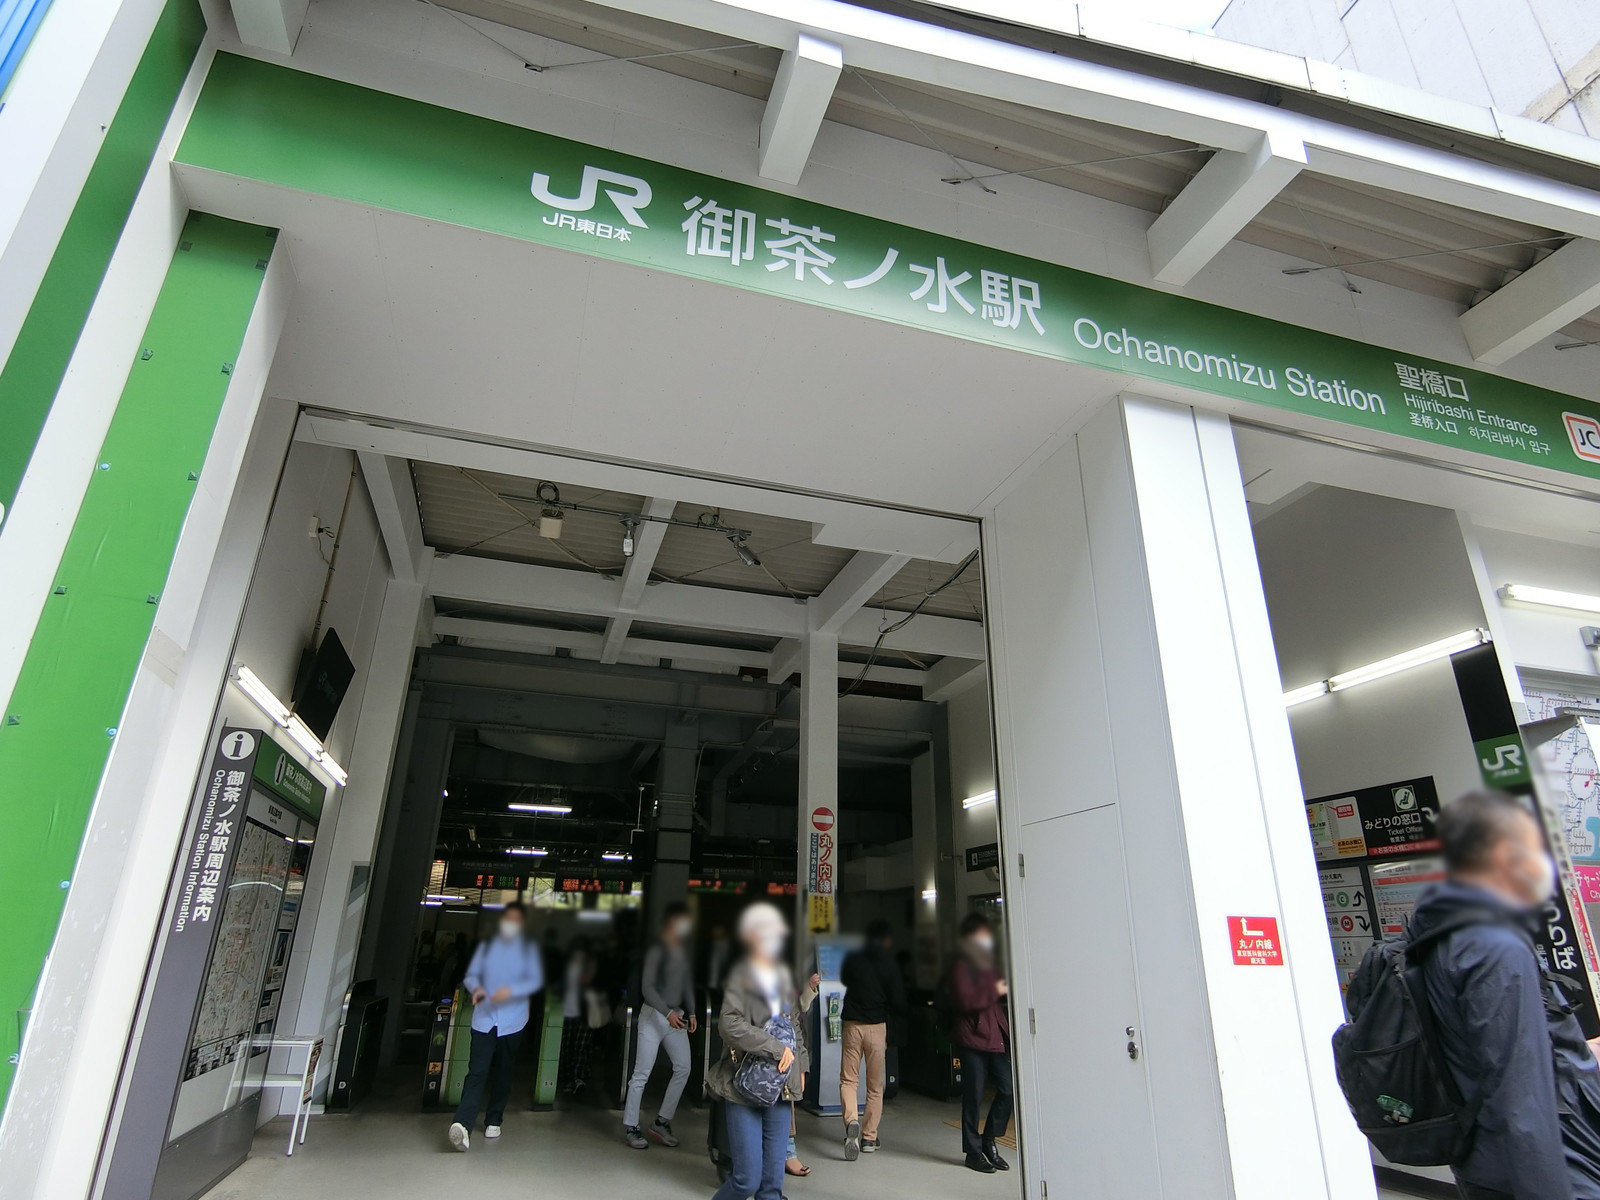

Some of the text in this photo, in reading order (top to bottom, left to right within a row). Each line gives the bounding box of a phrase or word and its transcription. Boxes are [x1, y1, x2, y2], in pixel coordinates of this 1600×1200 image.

[530, 165, 653, 229] JR
[543, 213, 633, 244] JR東日本
[681, 195, 1046, 336] 御茶ノ水駅
[1073, 317, 1386, 415] Ochanomizu Station
[1394, 362, 1470, 402] 聖橋口
[1403, 392, 1538, 436] Hijiribashi Entrance
[1529, 440, 1551, 456] 입구
[1482, 744, 1523, 771] JR
[192, 770, 246, 922] 御茶ノ水駅周辺案内
[1364, 812, 1421, 830] みどりの窓口
[175, 769, 226, 932] Ochanomizu Station Information
[809, 833, 819, 893] ここではありません
[819, 834, 833, 893] 丸ノ内線
[1239, 939, 1274, 950] 丸ノ内線
